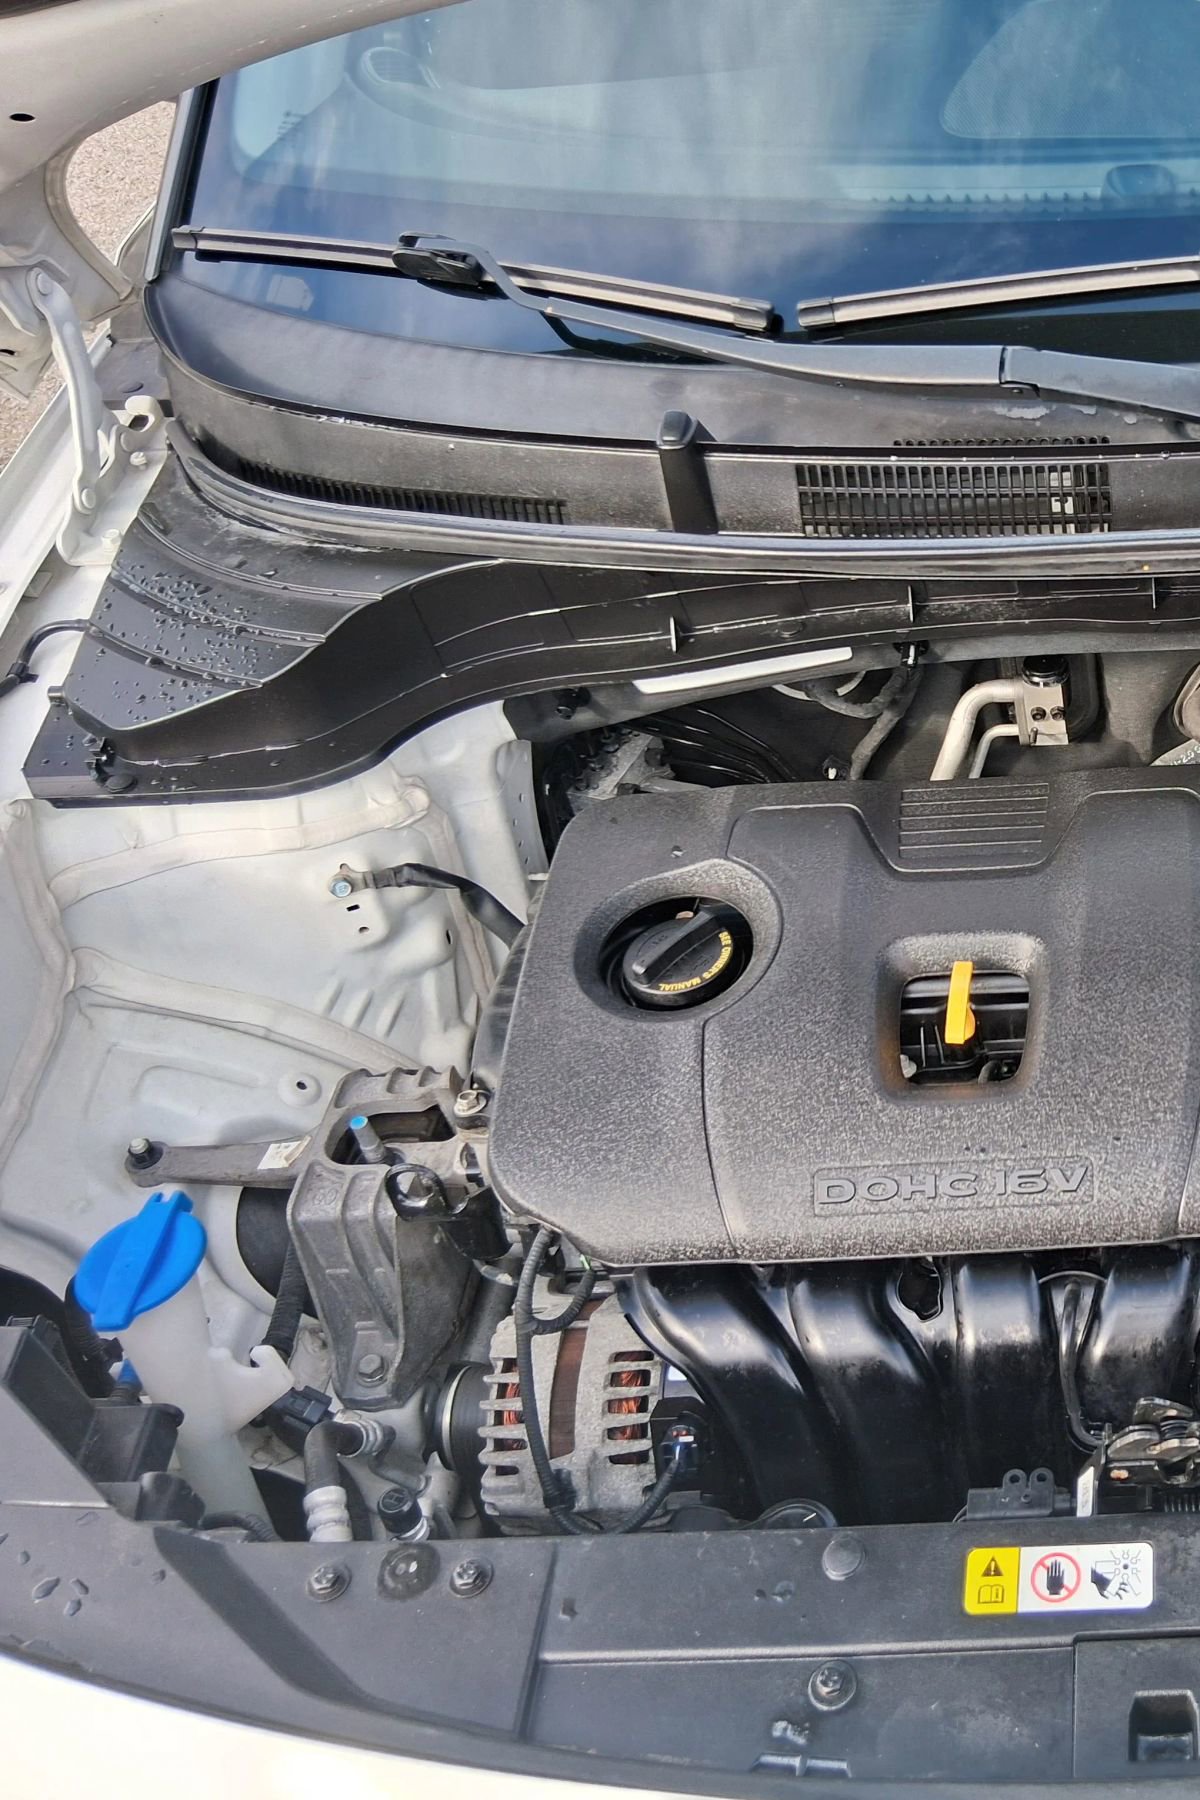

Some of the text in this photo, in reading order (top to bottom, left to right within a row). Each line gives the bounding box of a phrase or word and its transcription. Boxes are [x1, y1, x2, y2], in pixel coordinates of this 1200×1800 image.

[718, 931, 732, 946] SEE
[658, 976, 702, 992] MANUAL
[818, 1166, 1089, 1205] DOHC 16V
